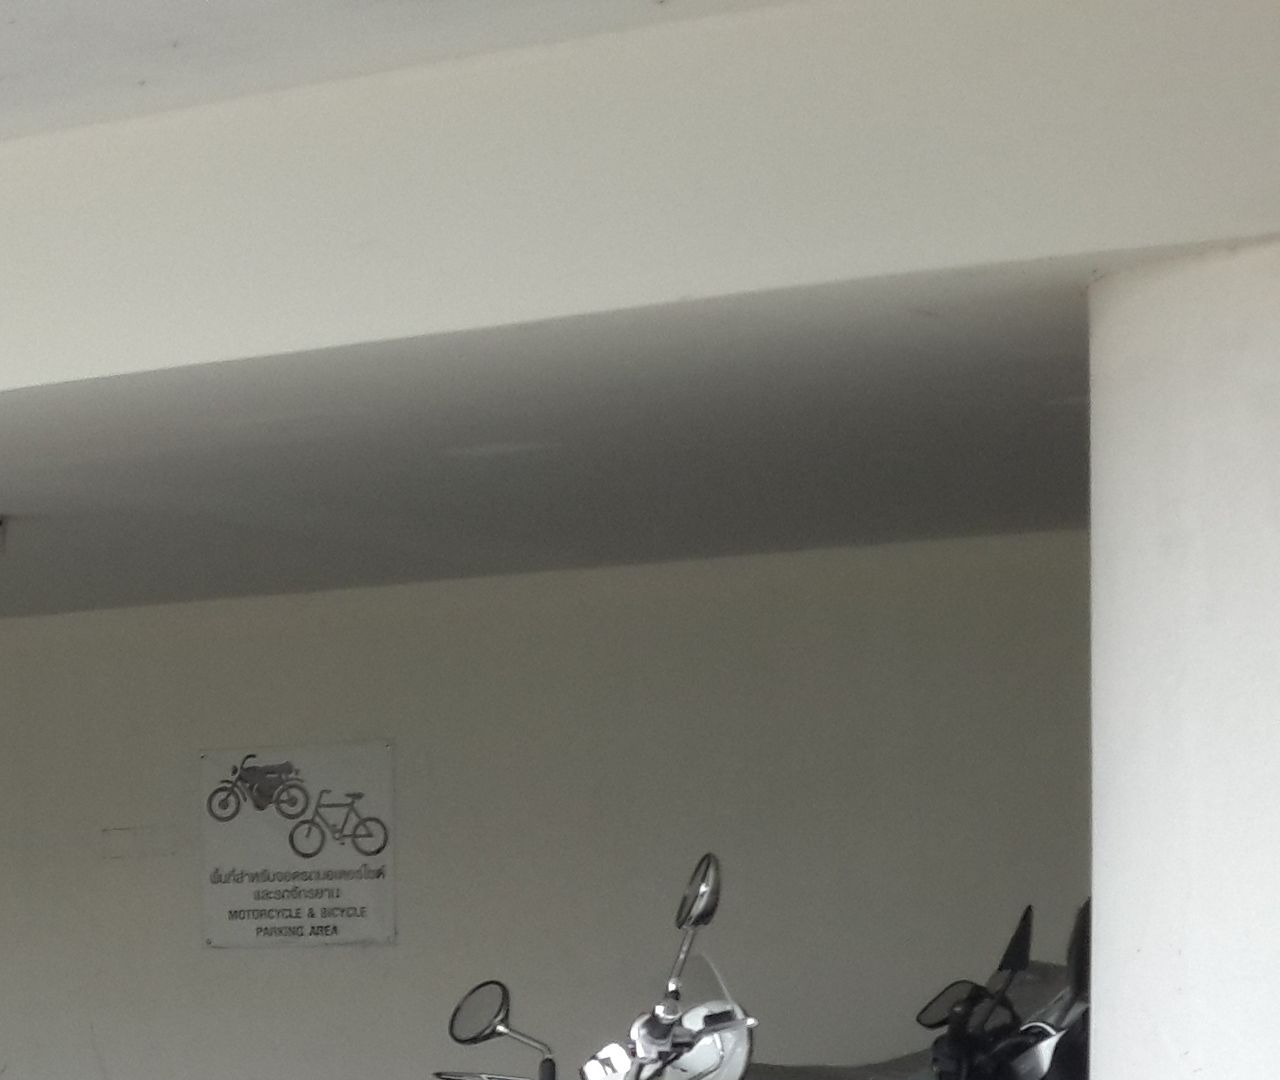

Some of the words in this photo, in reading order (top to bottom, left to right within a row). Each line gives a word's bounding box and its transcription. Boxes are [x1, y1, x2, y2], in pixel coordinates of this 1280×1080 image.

[228, 908, 302, 921] MOTORCYCLE
[307, 907, 316, 919] &
[320, 906, 367, 918] BICYCLE
[256, 926, 304, 938] PARKING
[309, 925, 338, 937] AREA
